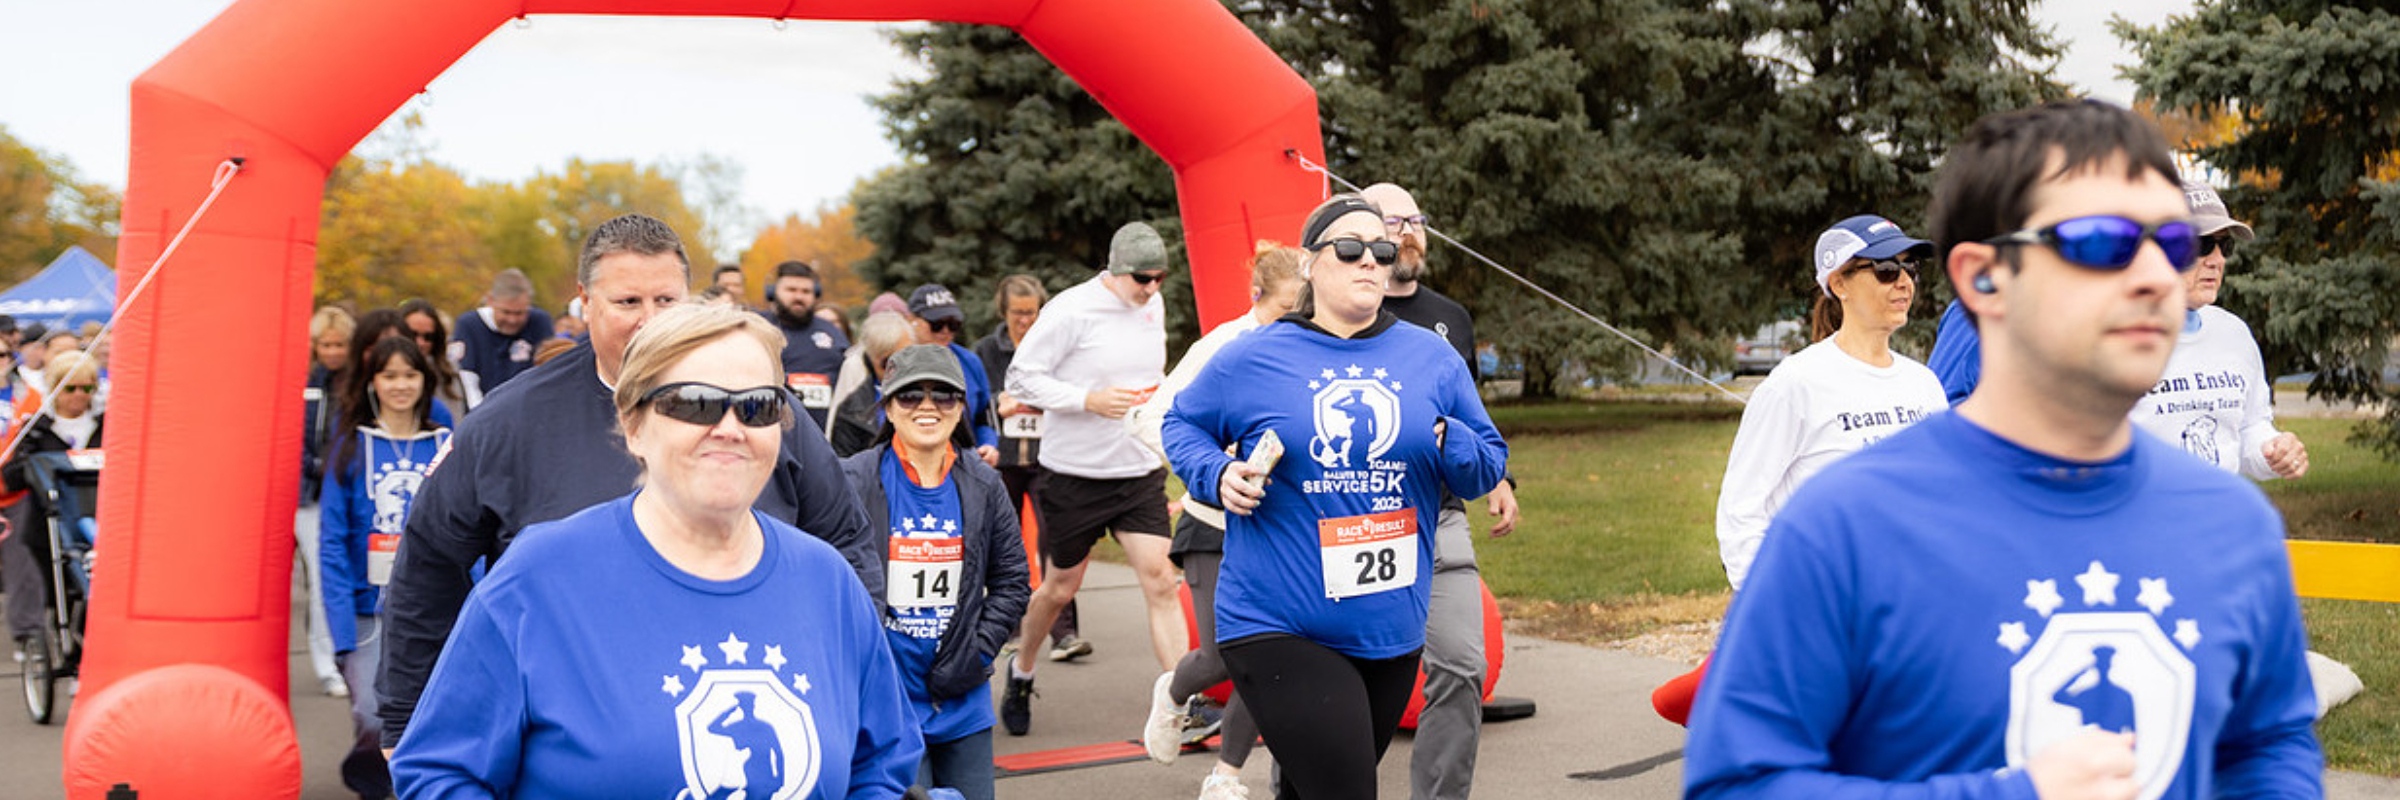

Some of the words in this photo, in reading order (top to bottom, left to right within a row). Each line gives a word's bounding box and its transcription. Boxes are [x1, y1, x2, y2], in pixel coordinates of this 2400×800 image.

[2194, 371, 2246, 393] Ensley
[2155, 404, 2164, 415] A
[2167, 400, 2214, 414] Drinking
[1018, 417, 1036, 431] 44
[1837, 410, 1892, 431] Team
[1302, 480, 1369, 493] SERVICE
[1369, 471, 1405, 494] 5K
[1323, 471, 1354, 480] SALUTE
[1356, 470, 1369, 479] TO
[1372, 496, 1403, 511] 2025
[1337, 525, 1363, 538] RACE
[1374, 519, 1405, 533] RESULT
[899, 545, 921, 554] RACE
[934, 545, 961, 555] RESULT
[1354, 547, 1396, 586] 28
[912, 569, 950, 598] 14
